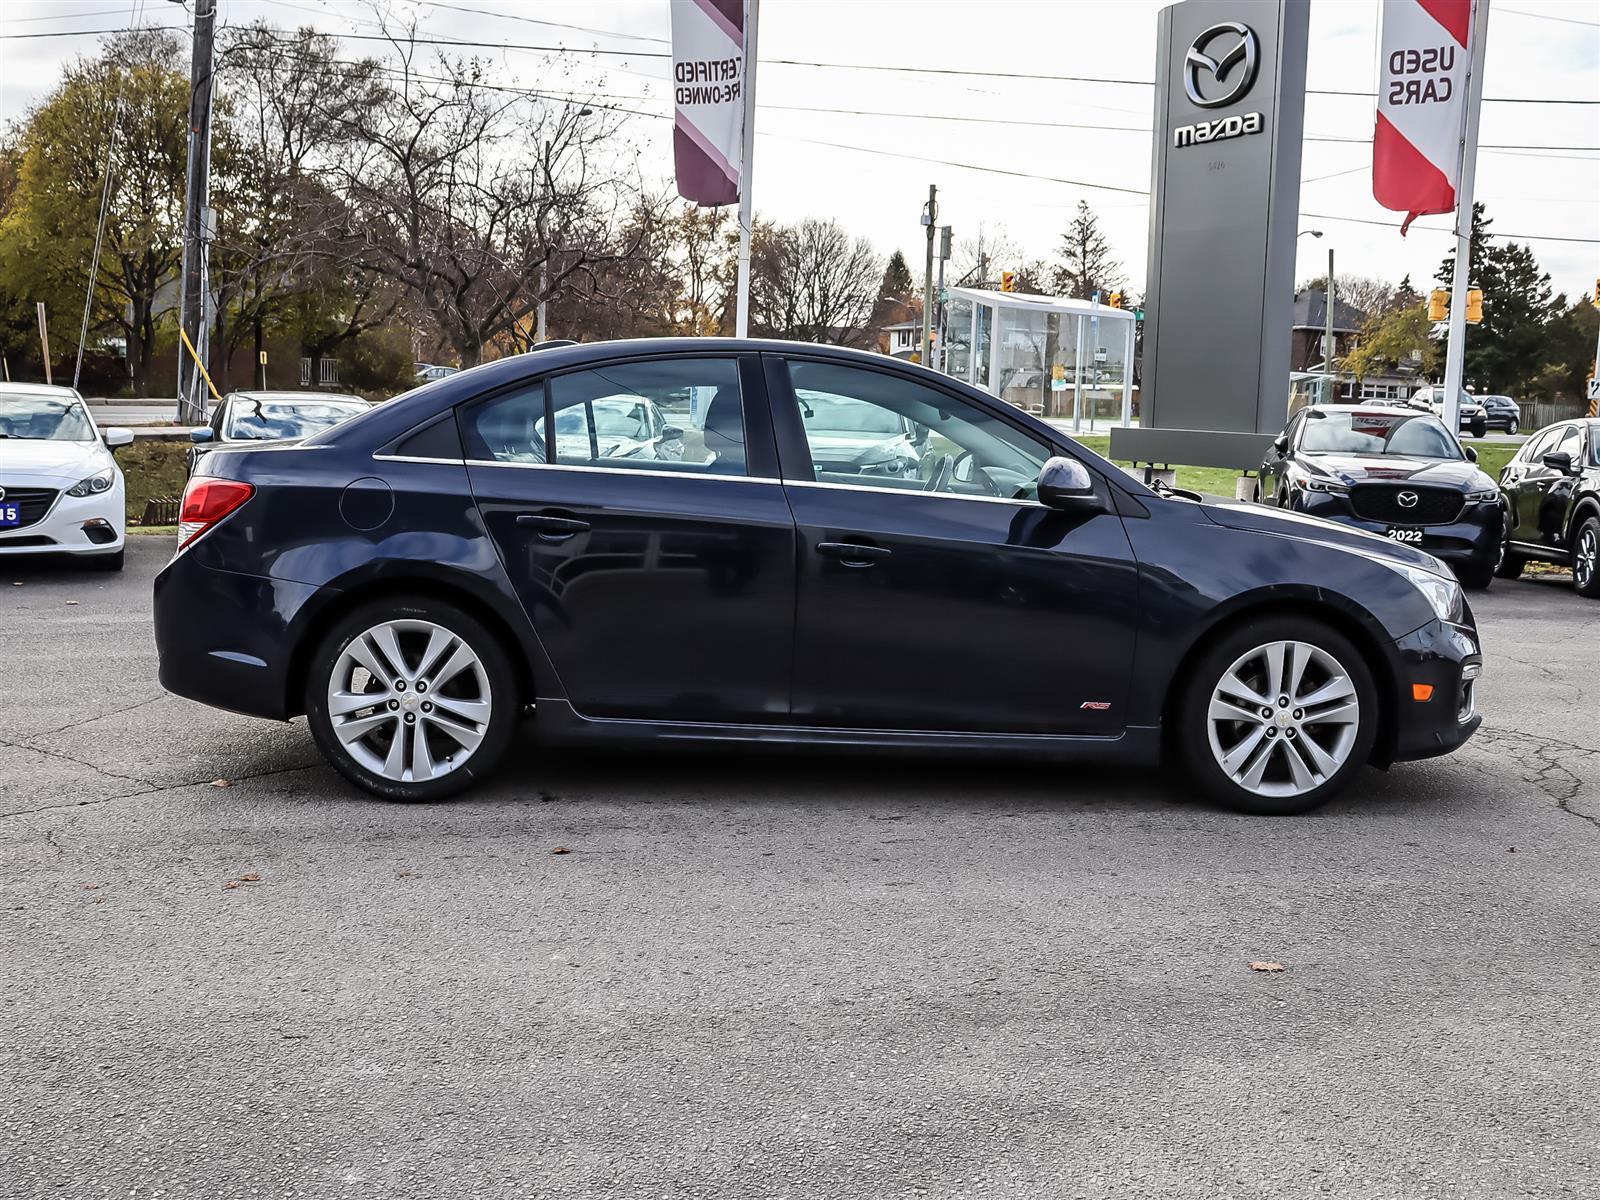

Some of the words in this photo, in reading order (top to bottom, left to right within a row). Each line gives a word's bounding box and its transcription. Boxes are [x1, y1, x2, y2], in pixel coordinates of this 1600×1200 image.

[1174, 112, 1263, 147] mazda
[1388, 529, 1423, 542] 2022
[1080, 701, 1111, 710] RS
